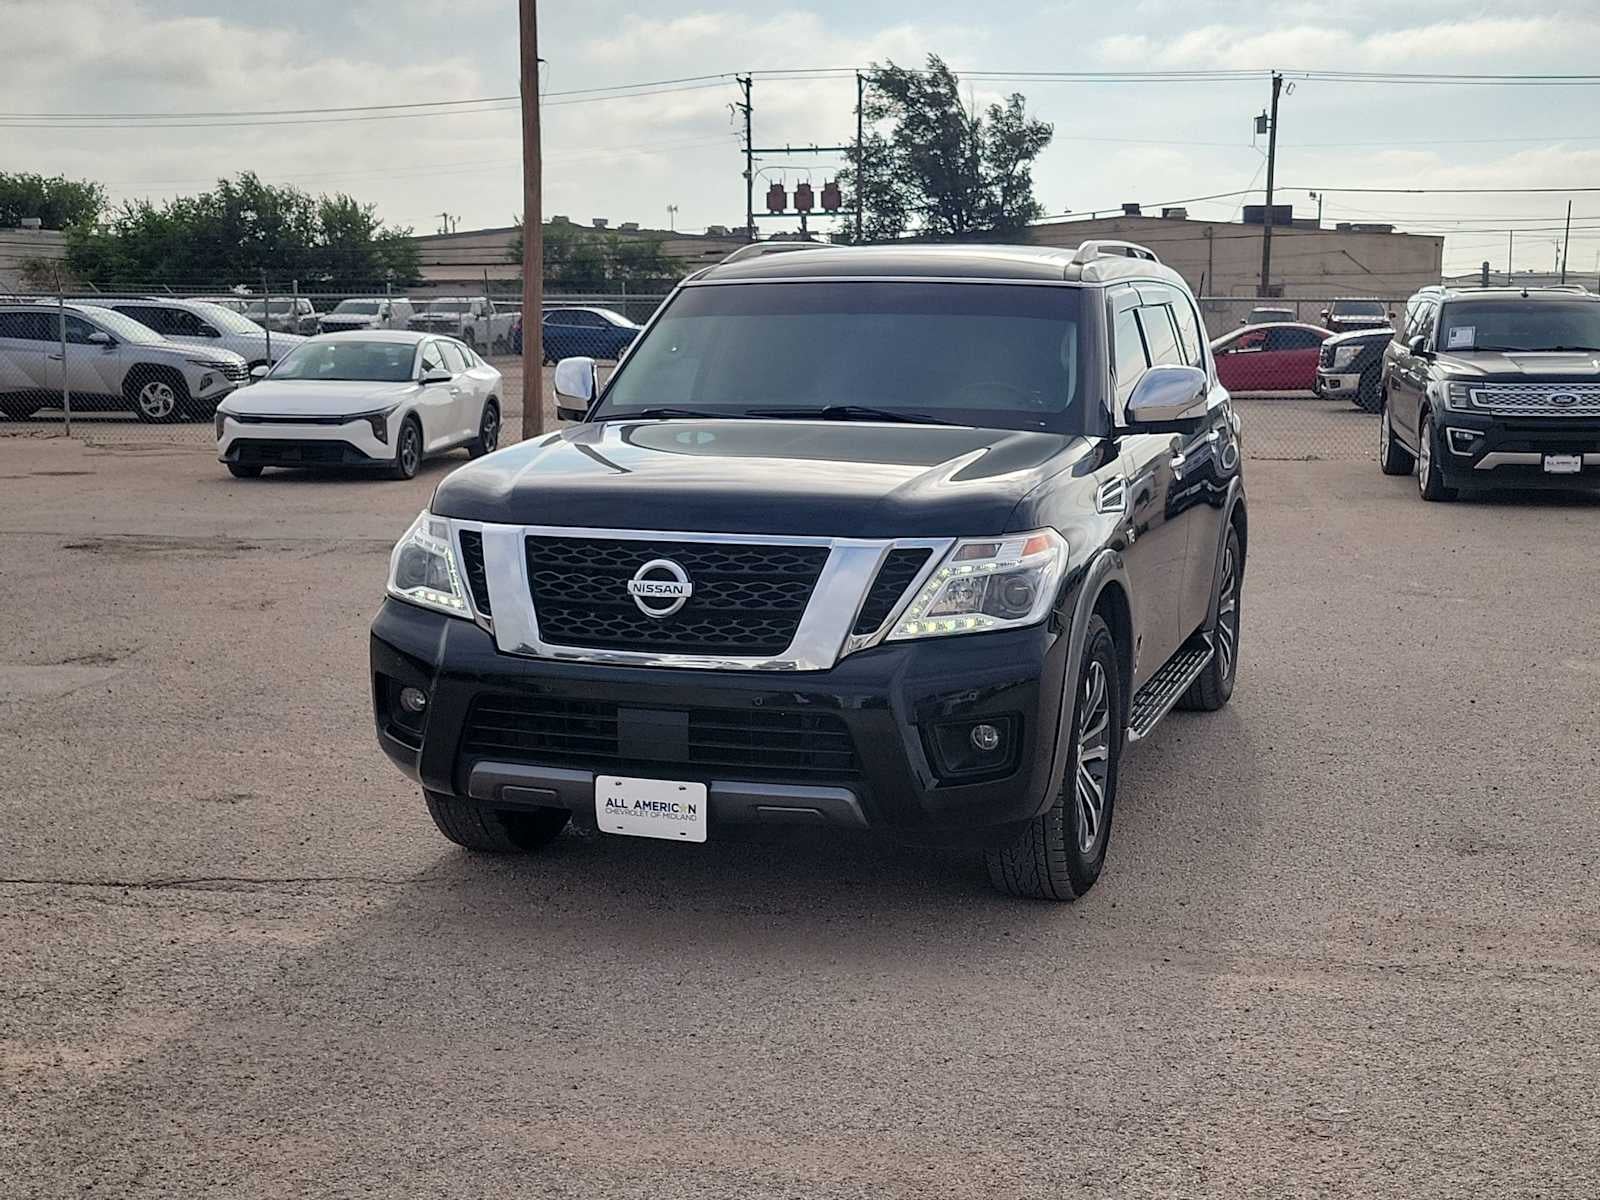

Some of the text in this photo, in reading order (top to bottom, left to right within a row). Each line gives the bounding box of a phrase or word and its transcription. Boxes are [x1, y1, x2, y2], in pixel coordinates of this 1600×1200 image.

[634, 584, 683, 594] NISSAN
[606, 797, 697, 814] ALL AMERICN
[605, 807, 648, 817] CHEVROLET
